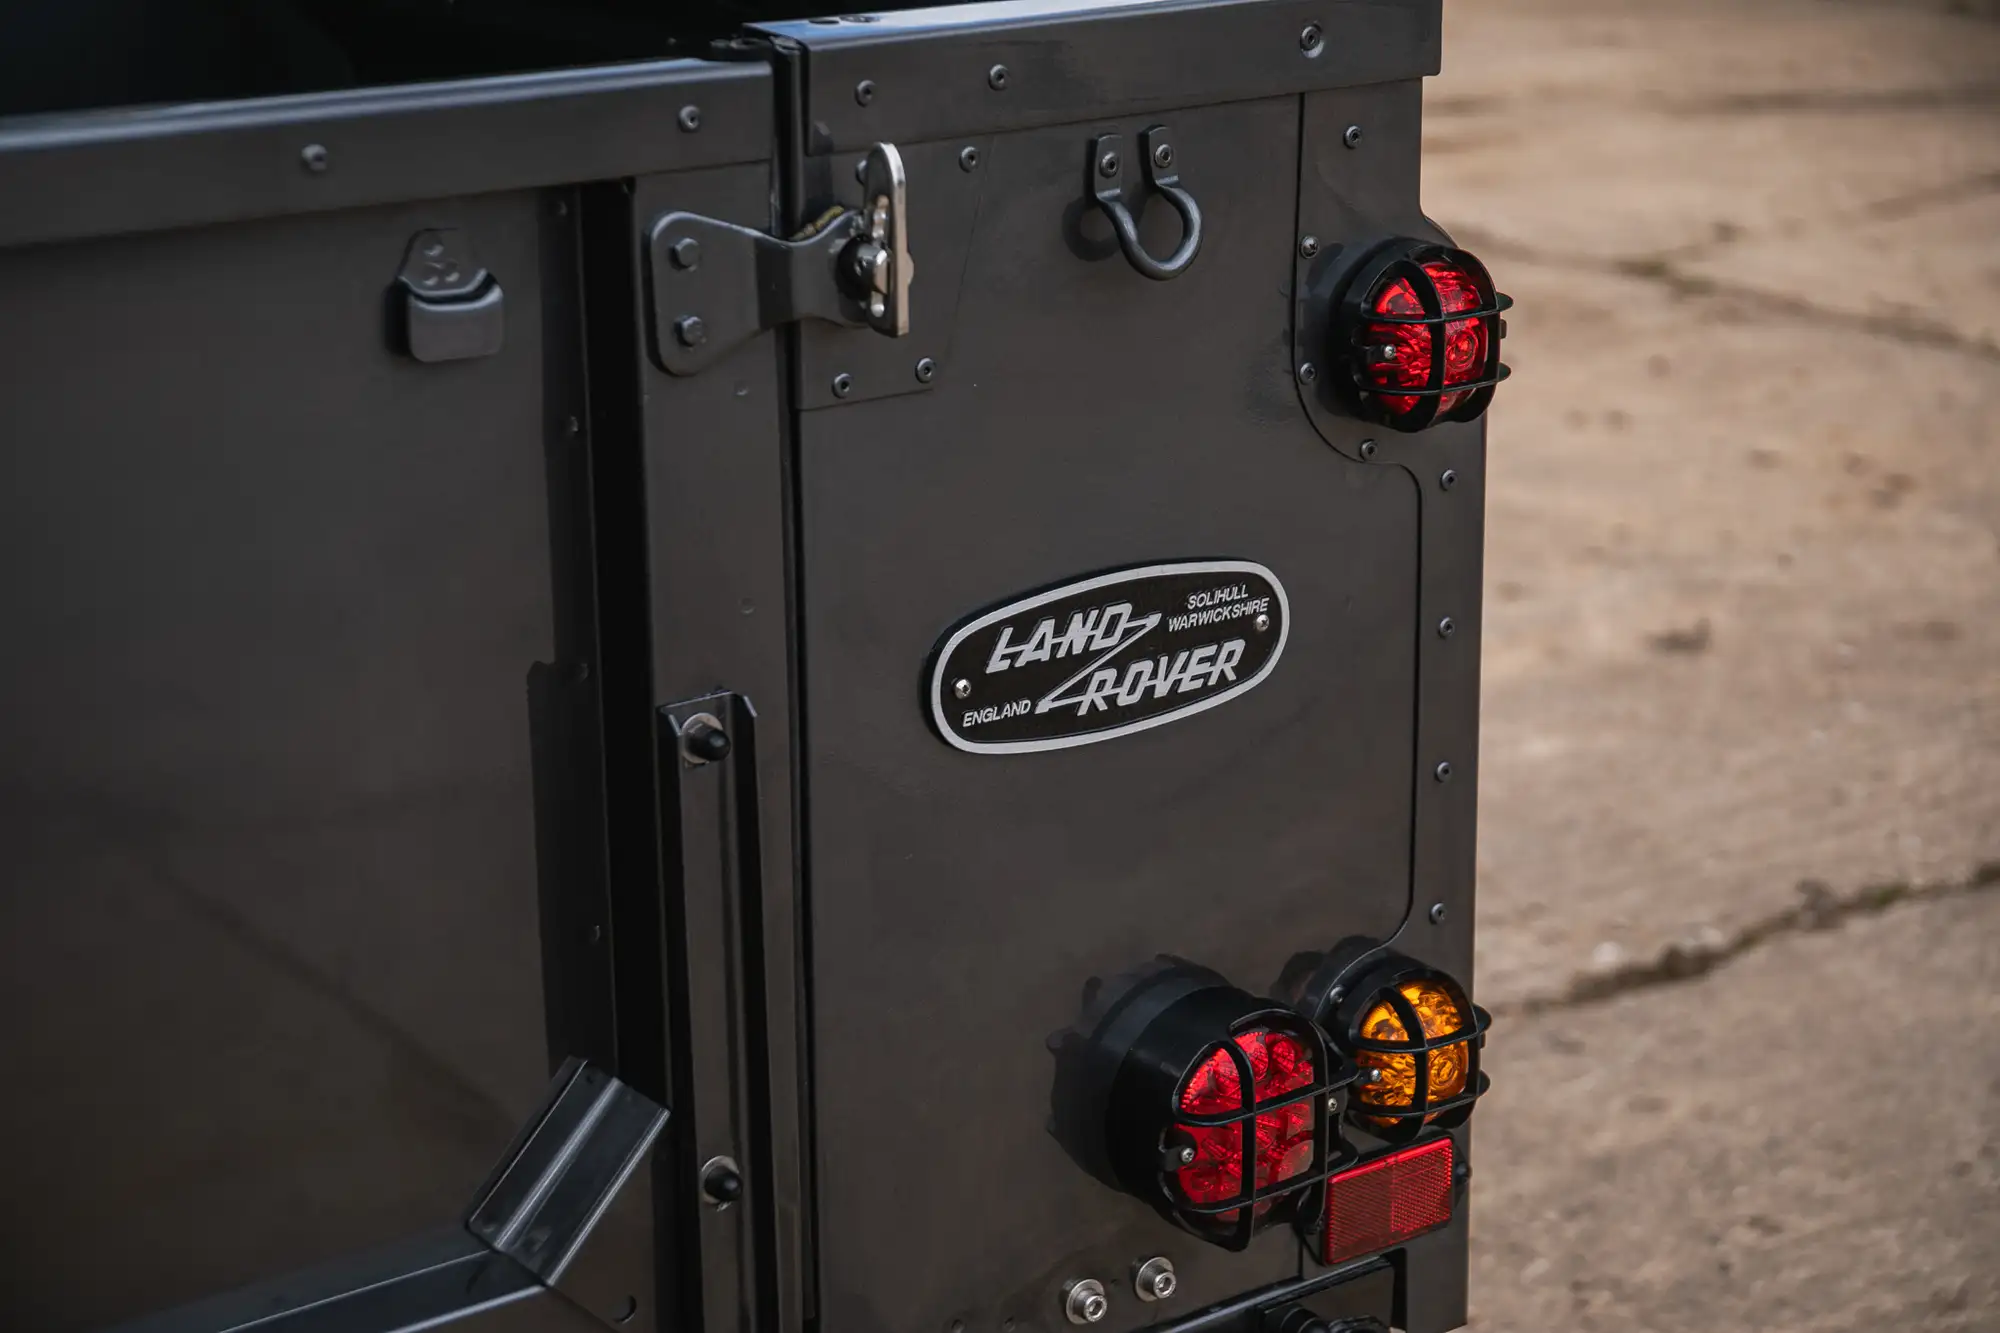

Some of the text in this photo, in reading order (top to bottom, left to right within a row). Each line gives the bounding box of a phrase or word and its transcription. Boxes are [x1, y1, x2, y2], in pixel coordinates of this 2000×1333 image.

[1187, 581, 1249, 609] SOLIHULL
[1168, 598, 1270, 632] WARWICKSHIRE
[985, 601, 1133, 674] LAND
[1076, 638, 1246, 717] ROVER
[962, 699, 1031, 727] ENGLAND
